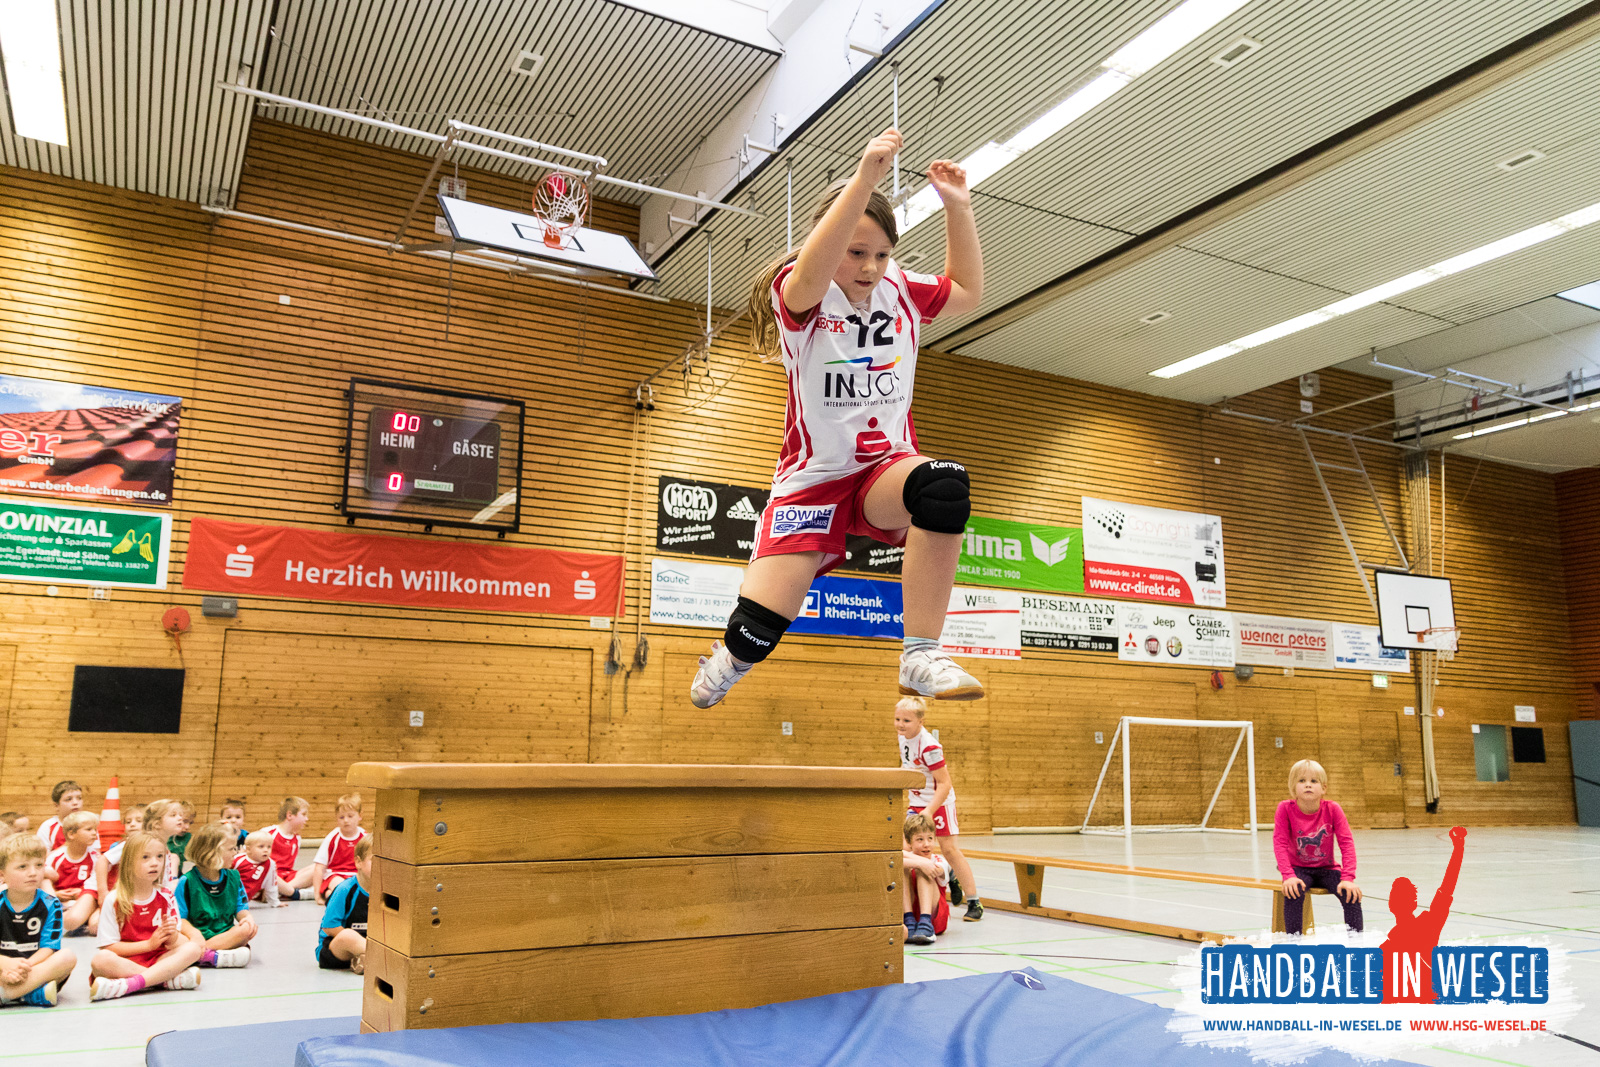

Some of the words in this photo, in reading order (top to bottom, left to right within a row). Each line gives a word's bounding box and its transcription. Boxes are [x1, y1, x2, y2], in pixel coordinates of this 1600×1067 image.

[845, 310, 893, 348] 12
[380, 432, 415, 449] HEIM
[452, 439, 494, 459] GÄSTE
[18, 455, 54, 466] GmbH
[929, 461, 965, 472] Kempa
[388, 473, 402, 491] 0
[672, 506, 709, 521] SPORT
[663, 526, 682, 535] Wir
[39, 536, 53, 544] der
[65, 538, 112, 548] Sparkassen
[661, 534, 699, 545] Sportler
[62, 551, 80, 559] und
[82, 551, 110, 561] Söhne
[285, 560, 393, 589] Herzlich
[400, 569, 551, 598] Willkommen
[656, 572, 690, 585] bautec
[982, 568, 1002, 578] SINCE
[1004, 570, 1021, 579] 1900
[1089, 579, 1181, 597] www.cr-direkt.de
[656, 594, 680, 603] Telefon
[824, 592, 883, 608] Volksbank
[1021, 597, 1115, 615] BIESEMANN
[824, 606, 890, 624] Rhein-Lippe
[1153, 616, 1176, 629] Jeep
[739, 625, 771, 647] Kempa
[1196, 627, 1230, 640] SCHMITZ
[1240, 629, 1284, 644] werner
[1288, 633, 1326, 648] peters
[934, 815, 945, 830] 3
[77, 865, 88, 880] 6
[252, 866, 265, 880] 3
[152, 908, 163, 926] 4
[26, 917, 41, 935] 9
